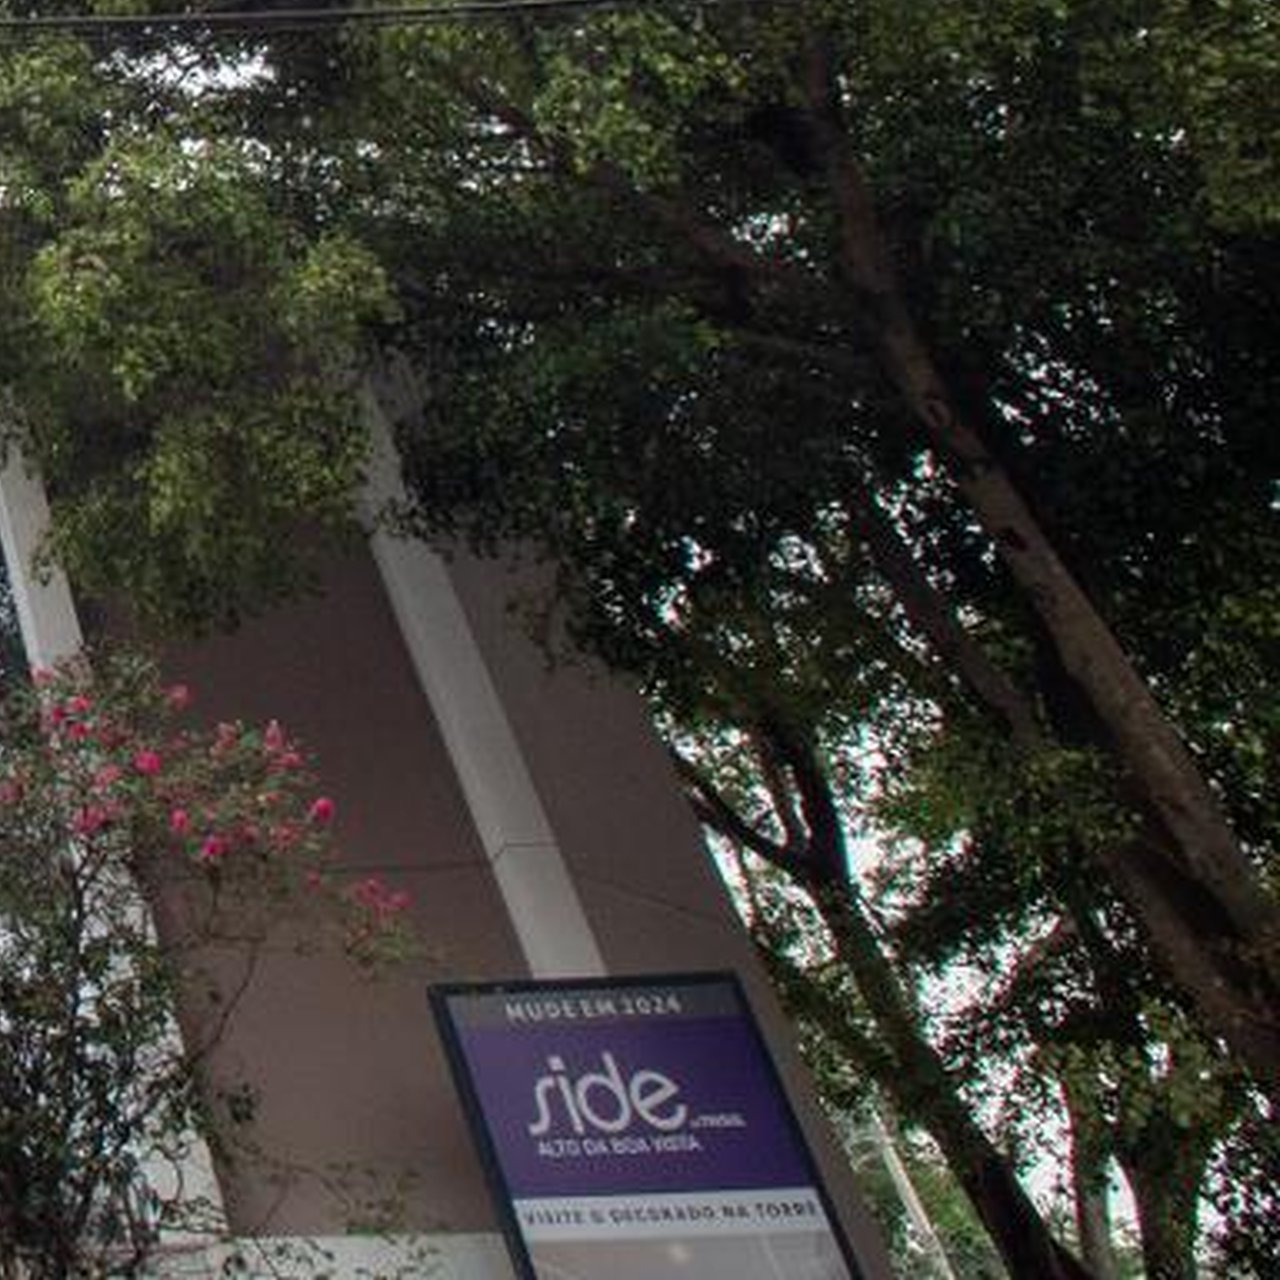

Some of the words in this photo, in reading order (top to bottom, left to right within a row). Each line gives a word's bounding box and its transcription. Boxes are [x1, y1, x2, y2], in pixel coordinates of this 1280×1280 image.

[505, 1000, 576, 1021] MUDE
[579, 998, 617, 1017] EM
[620, 993, 683, 1015] 2024
[528, 1051, 688, 1136] side
[539, 1137, 581, 1157] ALTO
[582, 1136, 609, 1155] DA
[611, 1135, 651, 1154] BOA
[652, 1133, 703, 1153] VISTA
[523, 1207, 584, 1225] VISITE
[721, 1202, 751, 1218] NA
